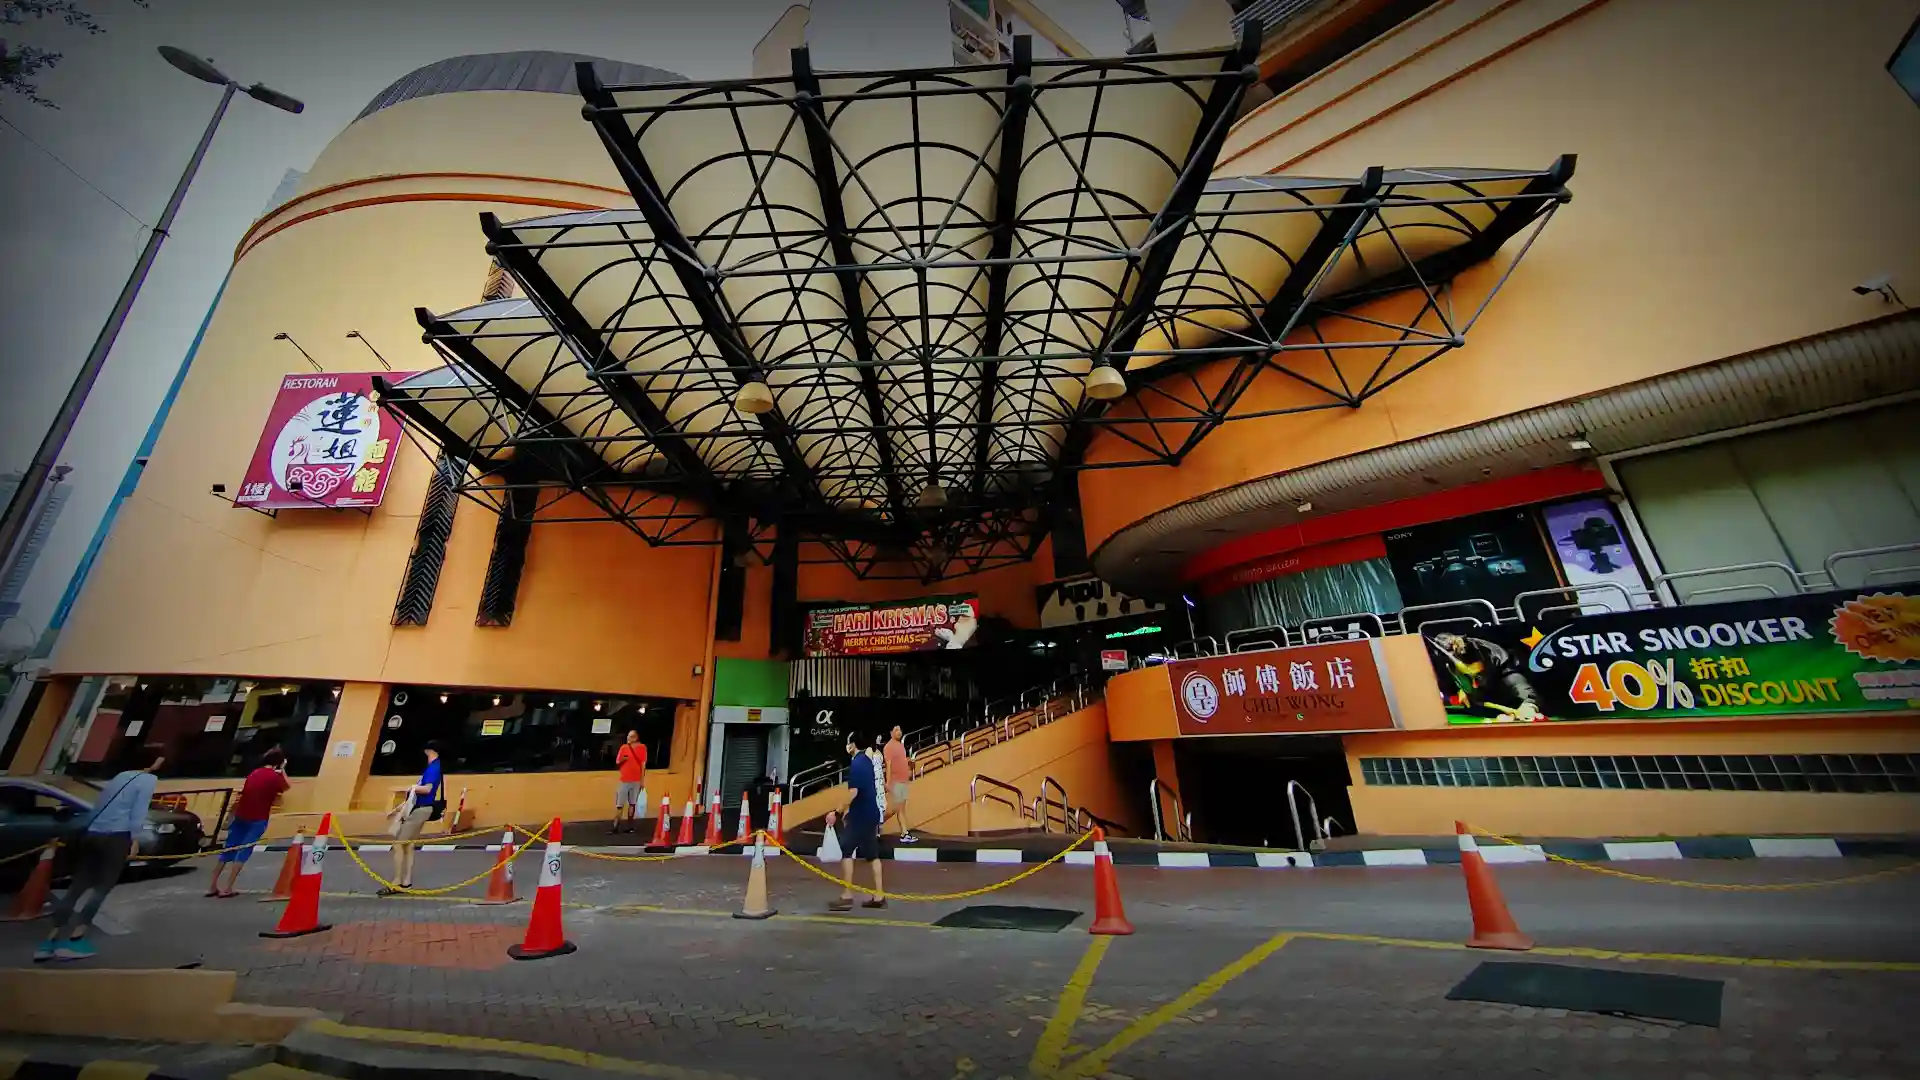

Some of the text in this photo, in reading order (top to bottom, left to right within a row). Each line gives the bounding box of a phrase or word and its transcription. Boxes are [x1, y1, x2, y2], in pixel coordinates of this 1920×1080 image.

[284, 378, 338, 389] RESTORAN
[1387, 531, 1413, 541] SONY
[834, 611, 870, 633] HARI
[873, 603, 948, 630] KRISMAS
[843, 636, 869, 647] MERRY
[869, 633, 914, 646] CHRISTMAS
[1558, 617, 1813, 658] STAR SNOOKER
[1222, 656, 1355, 697] 師傅飯店
[1689, 656, 1750, 680] 折扣
[1569, 658, 1696, 711] 40%
[1700, 677, 1841, 708] DISCOUNT
[1285, 693, 1344, 710] WONG
[810, 727, 840, 737] GARDEN
